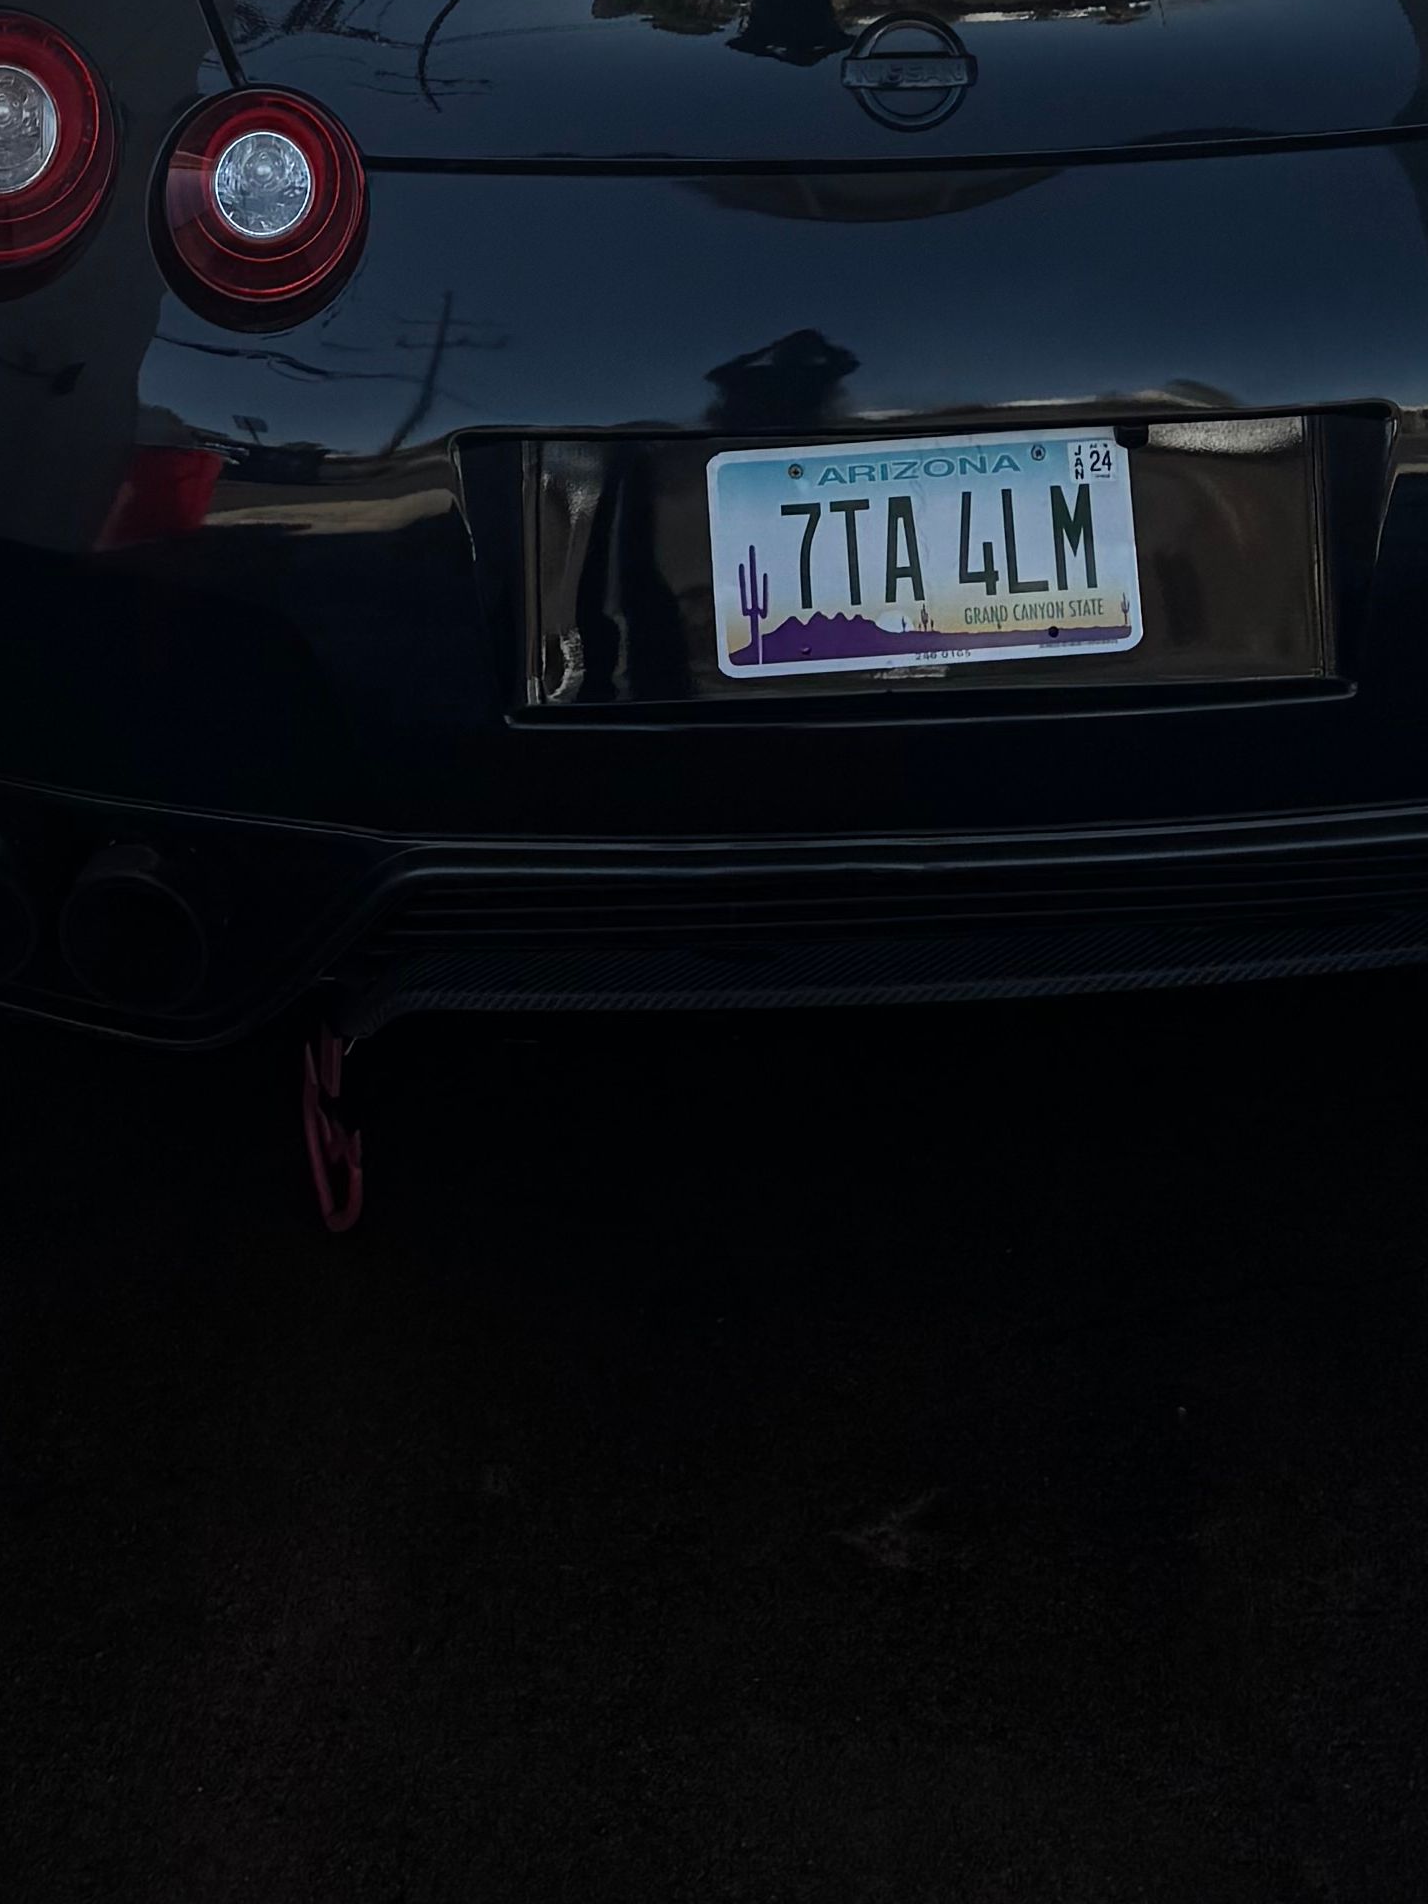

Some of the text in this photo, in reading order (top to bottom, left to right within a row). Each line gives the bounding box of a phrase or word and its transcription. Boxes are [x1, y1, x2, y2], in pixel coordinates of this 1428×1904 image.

[853, 61, 963, 83] NISSAN
[817, 454, 1021, 486] ARIZONA
[1074, 444, 1084, 480] JAN
[1089, 450, 1112, 472] 24
[780, 483, 1098, 609] 7TA 4LM
[964, 598, 1104, 625] GRAND CANYON STATE
